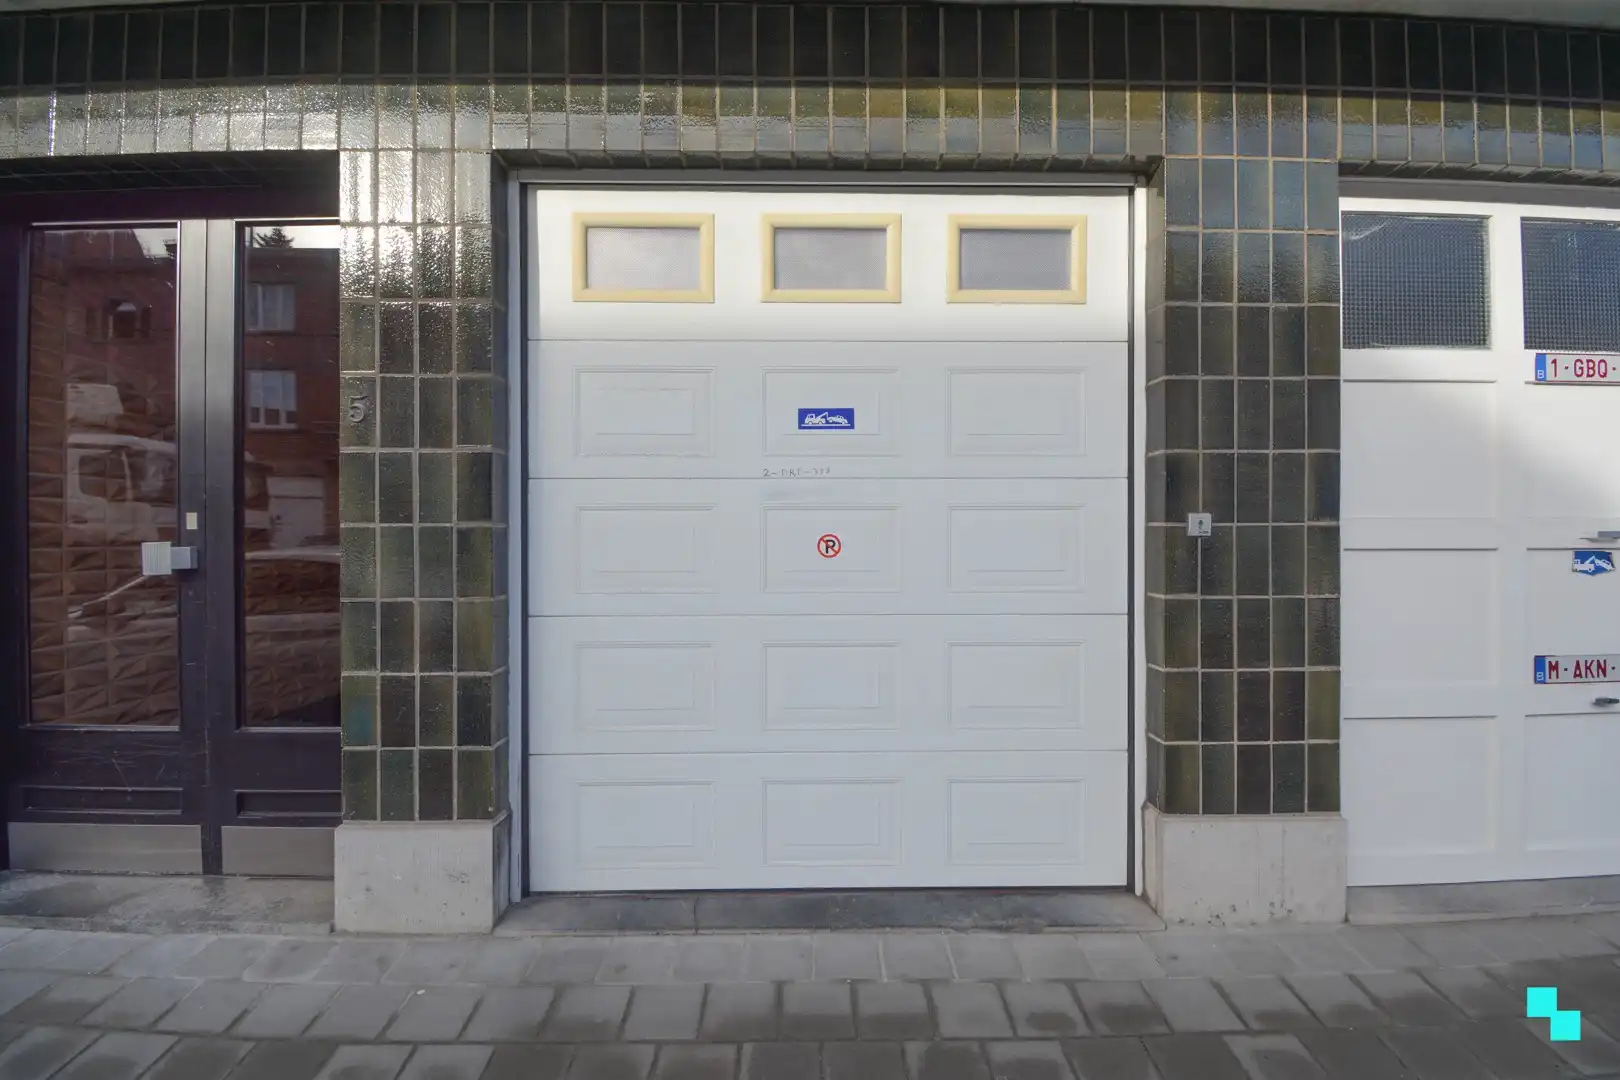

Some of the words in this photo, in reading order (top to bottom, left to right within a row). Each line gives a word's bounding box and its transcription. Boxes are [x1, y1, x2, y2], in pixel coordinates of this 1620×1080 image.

[1537, 369, 1545, 379] B
[348, 395, 366, 423] 5
[825, 539, 836, 554] P
[1536, 671, 1544, 681] B
